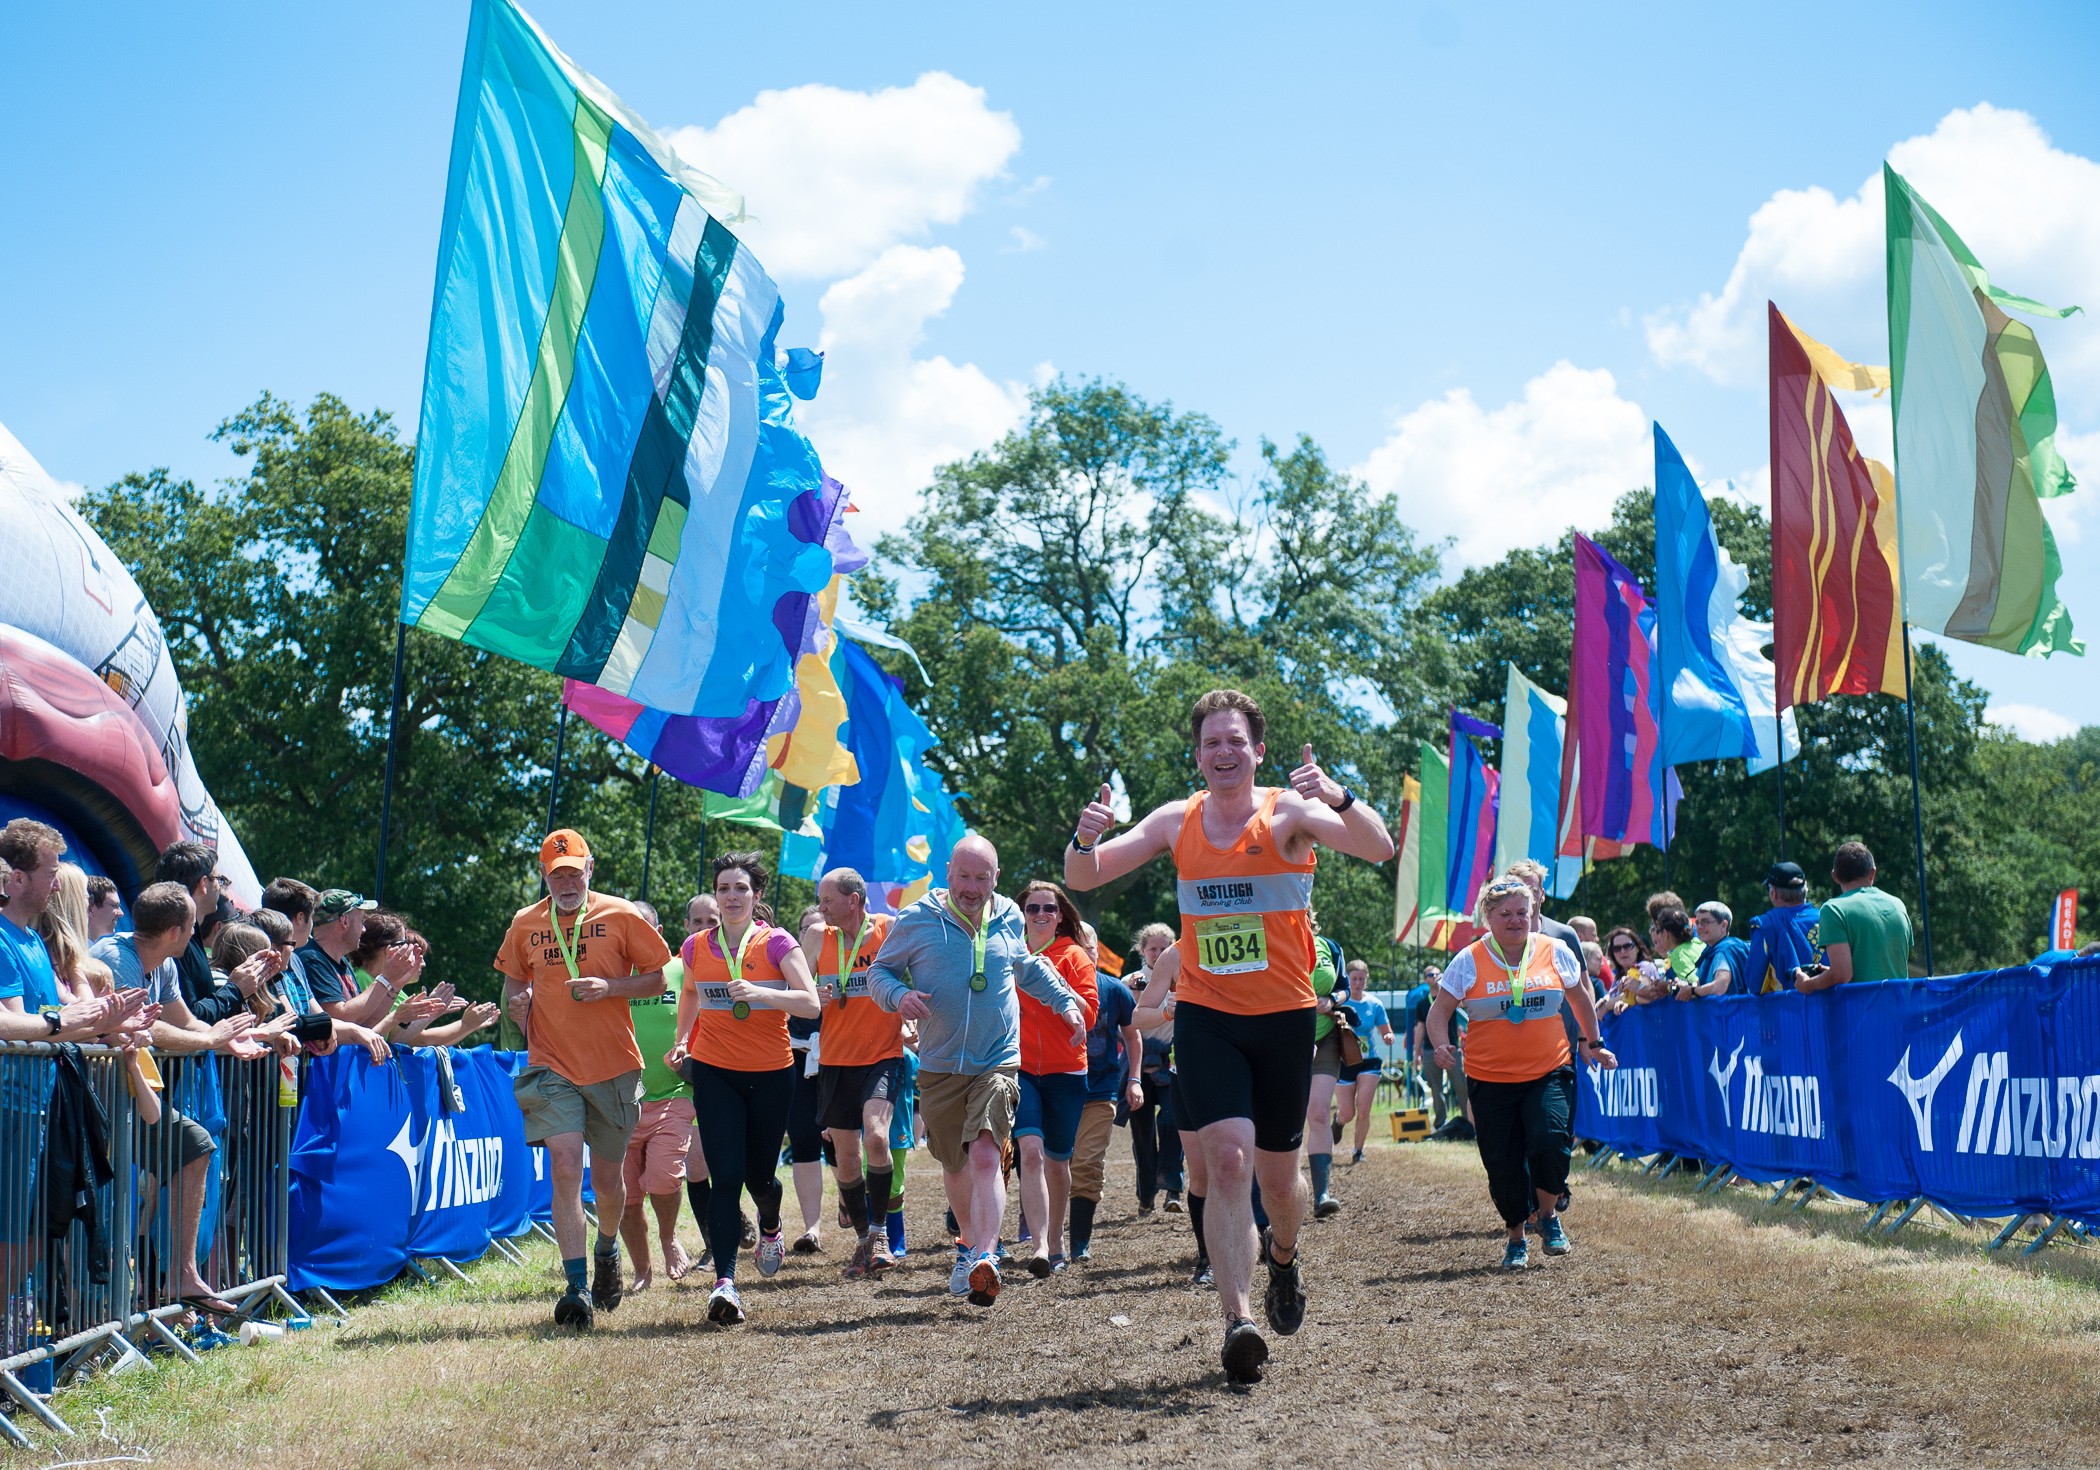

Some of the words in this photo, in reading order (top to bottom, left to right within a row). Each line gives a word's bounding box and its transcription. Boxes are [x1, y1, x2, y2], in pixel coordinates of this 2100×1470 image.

[1196, 883, 1254, 900] EASTLEIGH
[1201, 899, 1231, 908] Running
[1234, 898, 1253, 906] Club
[2063, 897, 2073, 949] READI
[1205, 933, 1261, 965] 1034
[704, 987, 732, 999] EASTL
[1486, 975, 1554, 995] BARARA
[1741, 1055, 1821, 1140] MIZUNO
[1956, 1051, 2100, 1159] MIZUNO
[424, 1118, 504, 1212] MIZUNO
